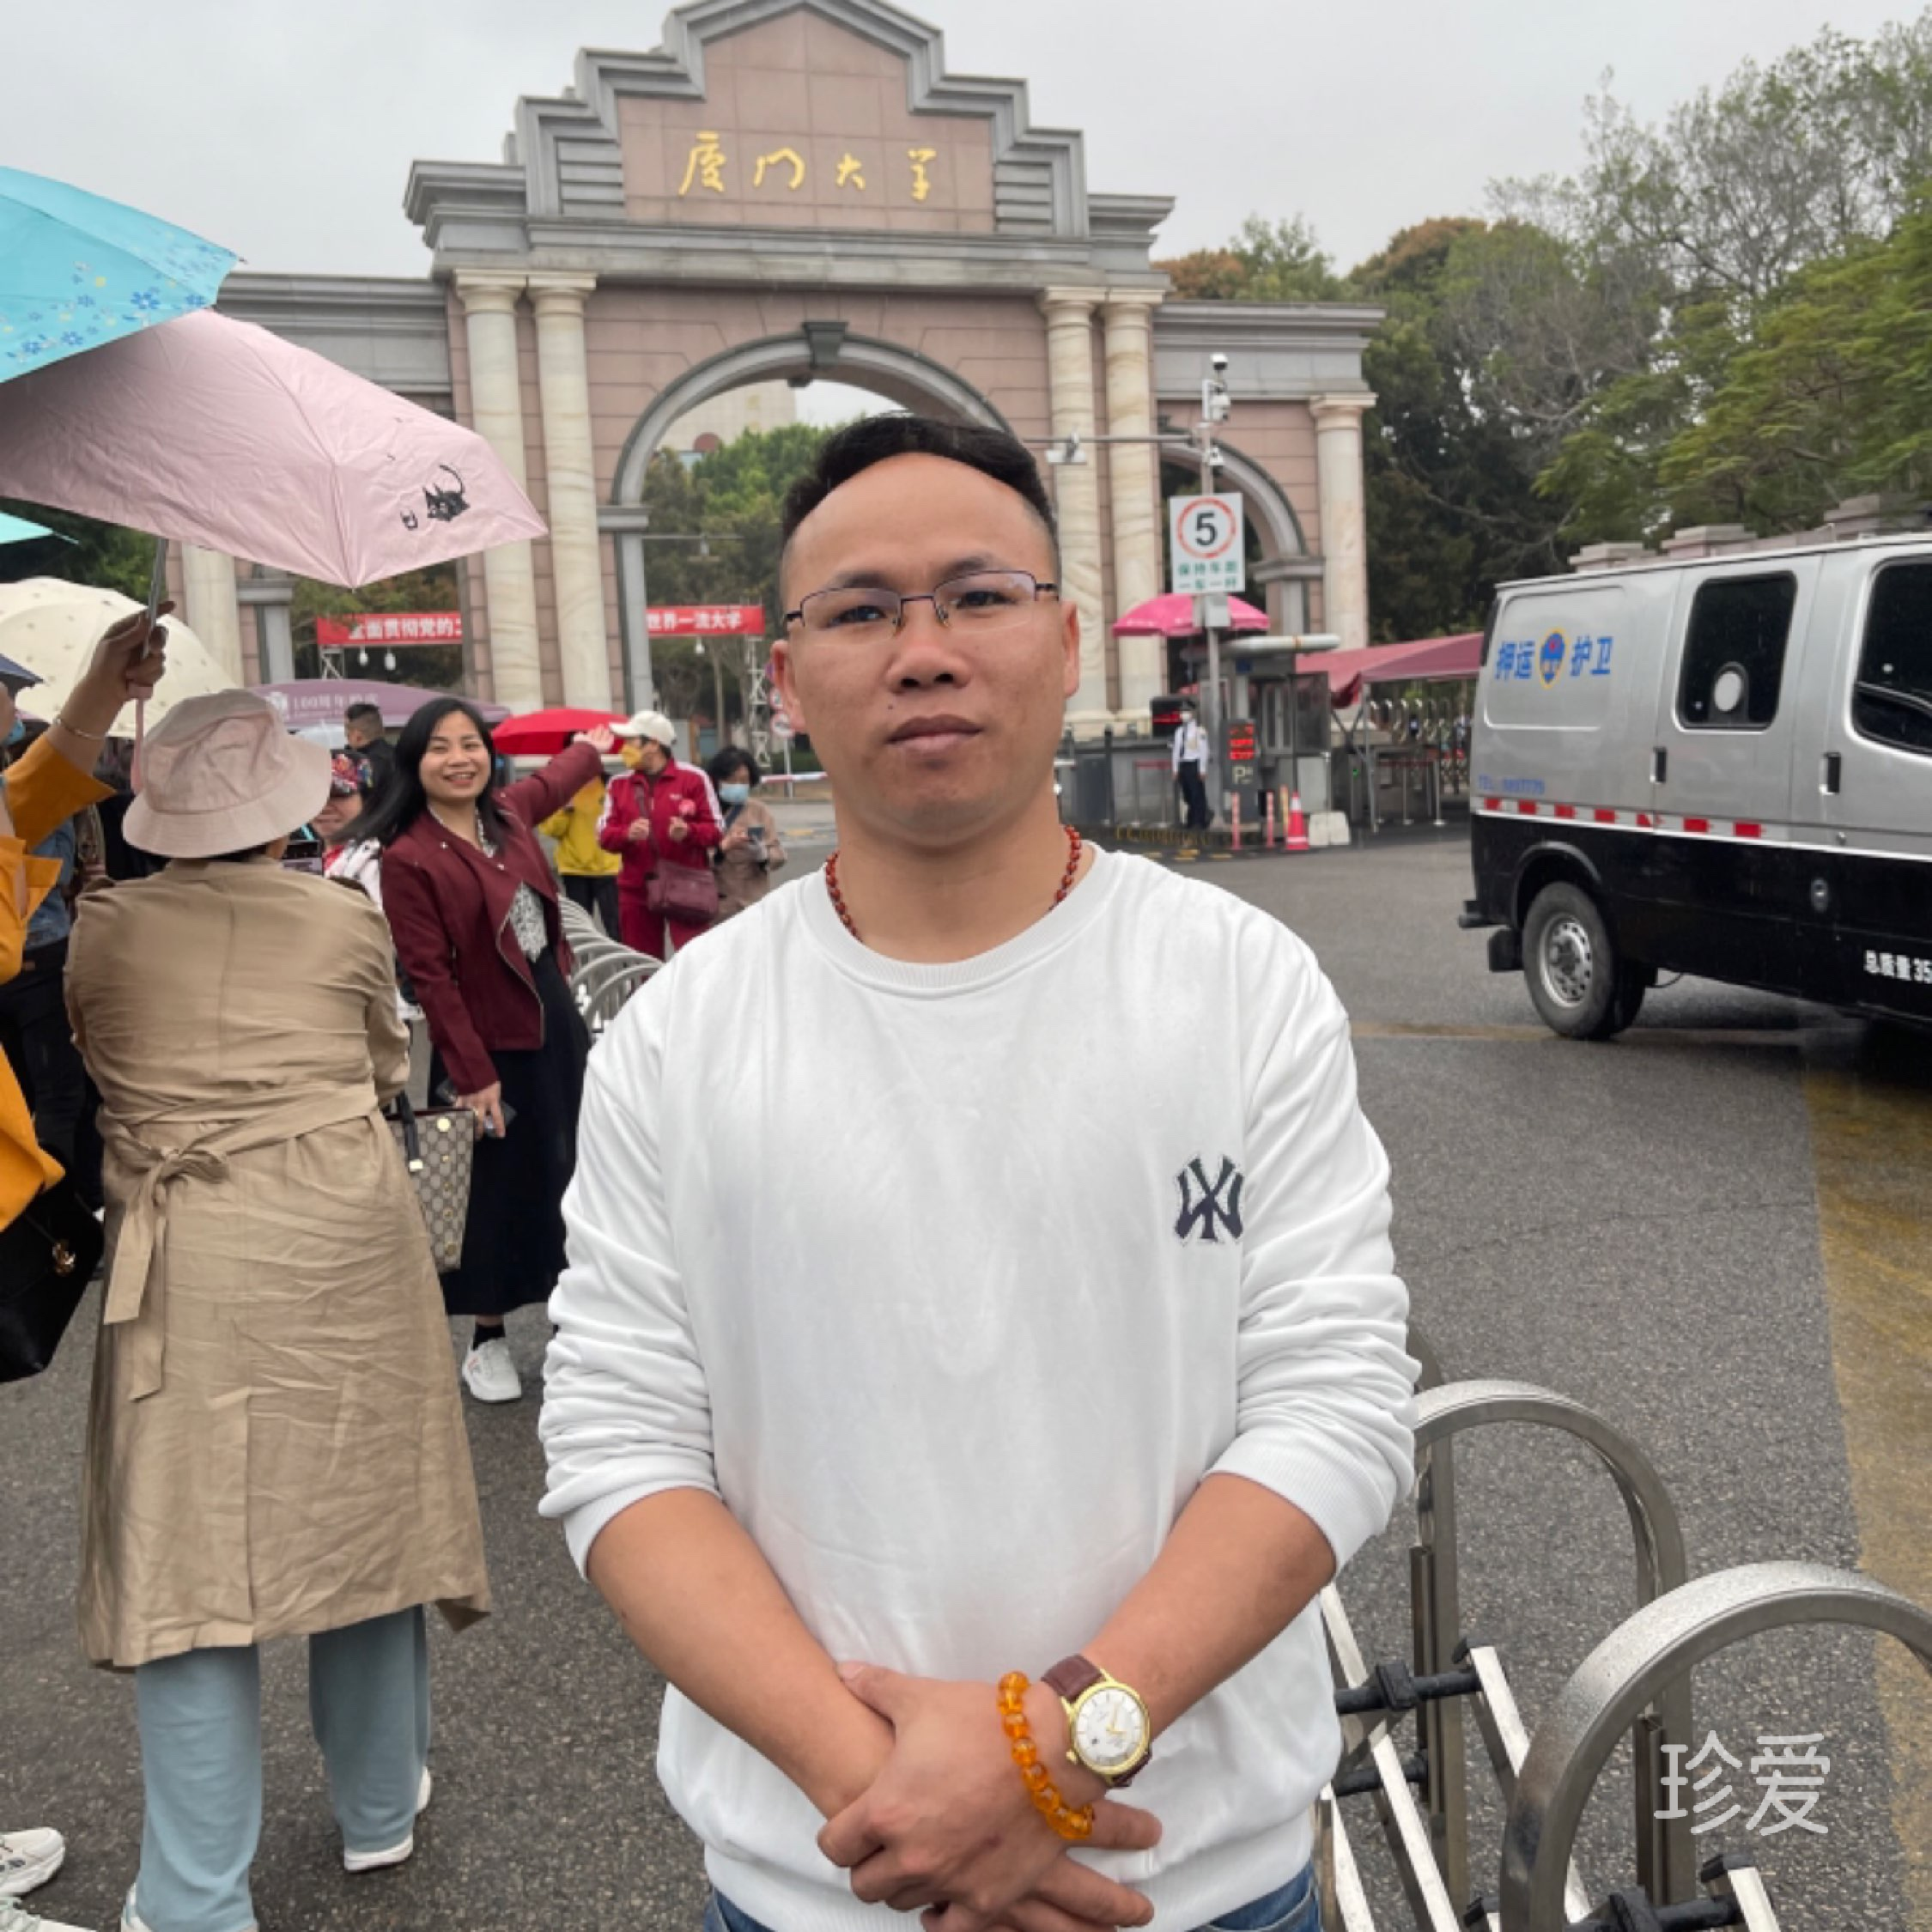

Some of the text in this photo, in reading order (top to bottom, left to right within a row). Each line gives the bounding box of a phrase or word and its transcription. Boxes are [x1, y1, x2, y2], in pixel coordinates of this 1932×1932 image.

[678, 131, 937, 201] 厦门大学
[1195, 511, 1218, 546] 5
[647, 611, 742, 631] 世界一流大学
[1495, 636, 1613, 680] 押运 护卫
